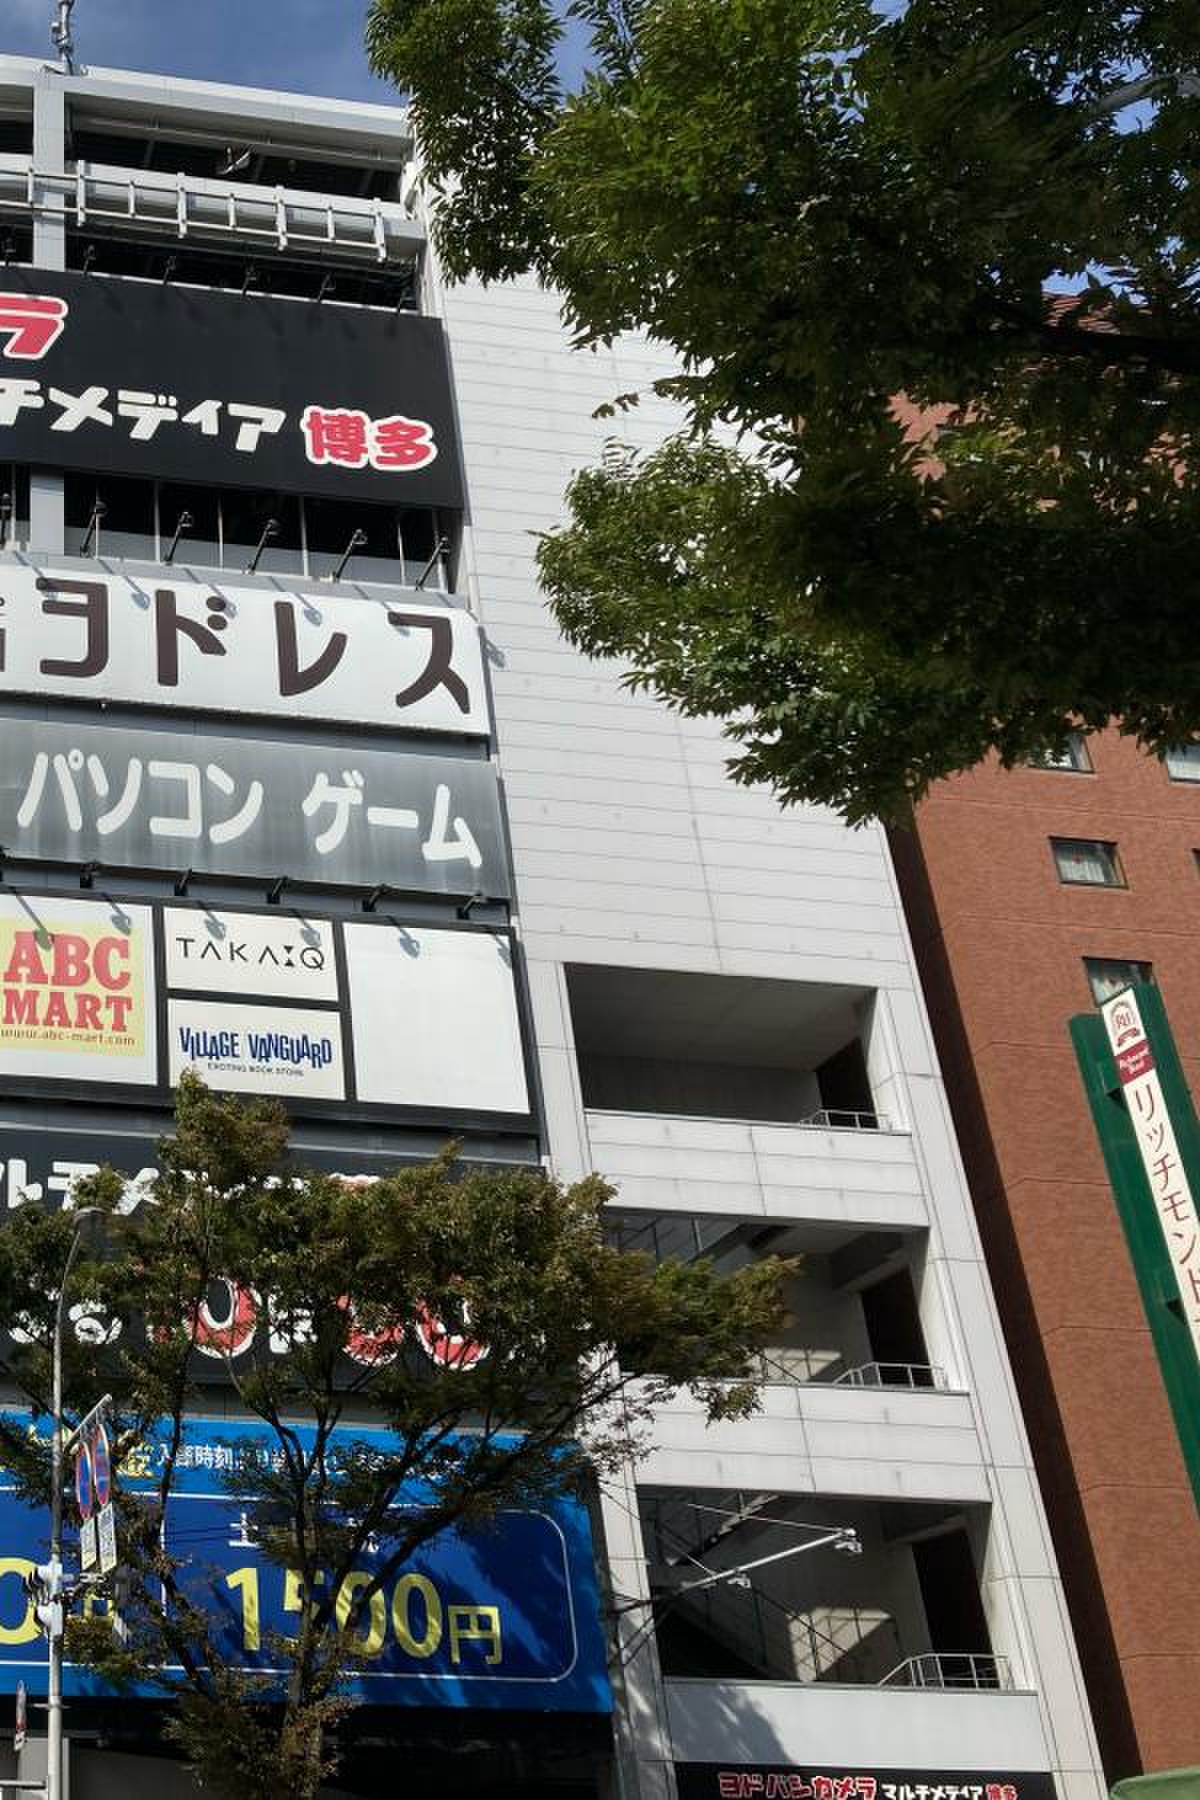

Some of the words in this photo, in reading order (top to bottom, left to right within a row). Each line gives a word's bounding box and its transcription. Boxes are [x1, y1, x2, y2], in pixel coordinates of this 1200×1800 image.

[300, 405, 439, 472] 博多
[35, 576, 471, 715] ヨドレス
[16, 748, 265, 845] パソコン
[301, 768, 484, 868] ゲーム
[2, 930, 132, 990] ABC
[2, 988, 134, 1032] MART
[178, 1026, 241, 1061] VILLAGE
[247, 1032, 333, 1069] VANGUARD
